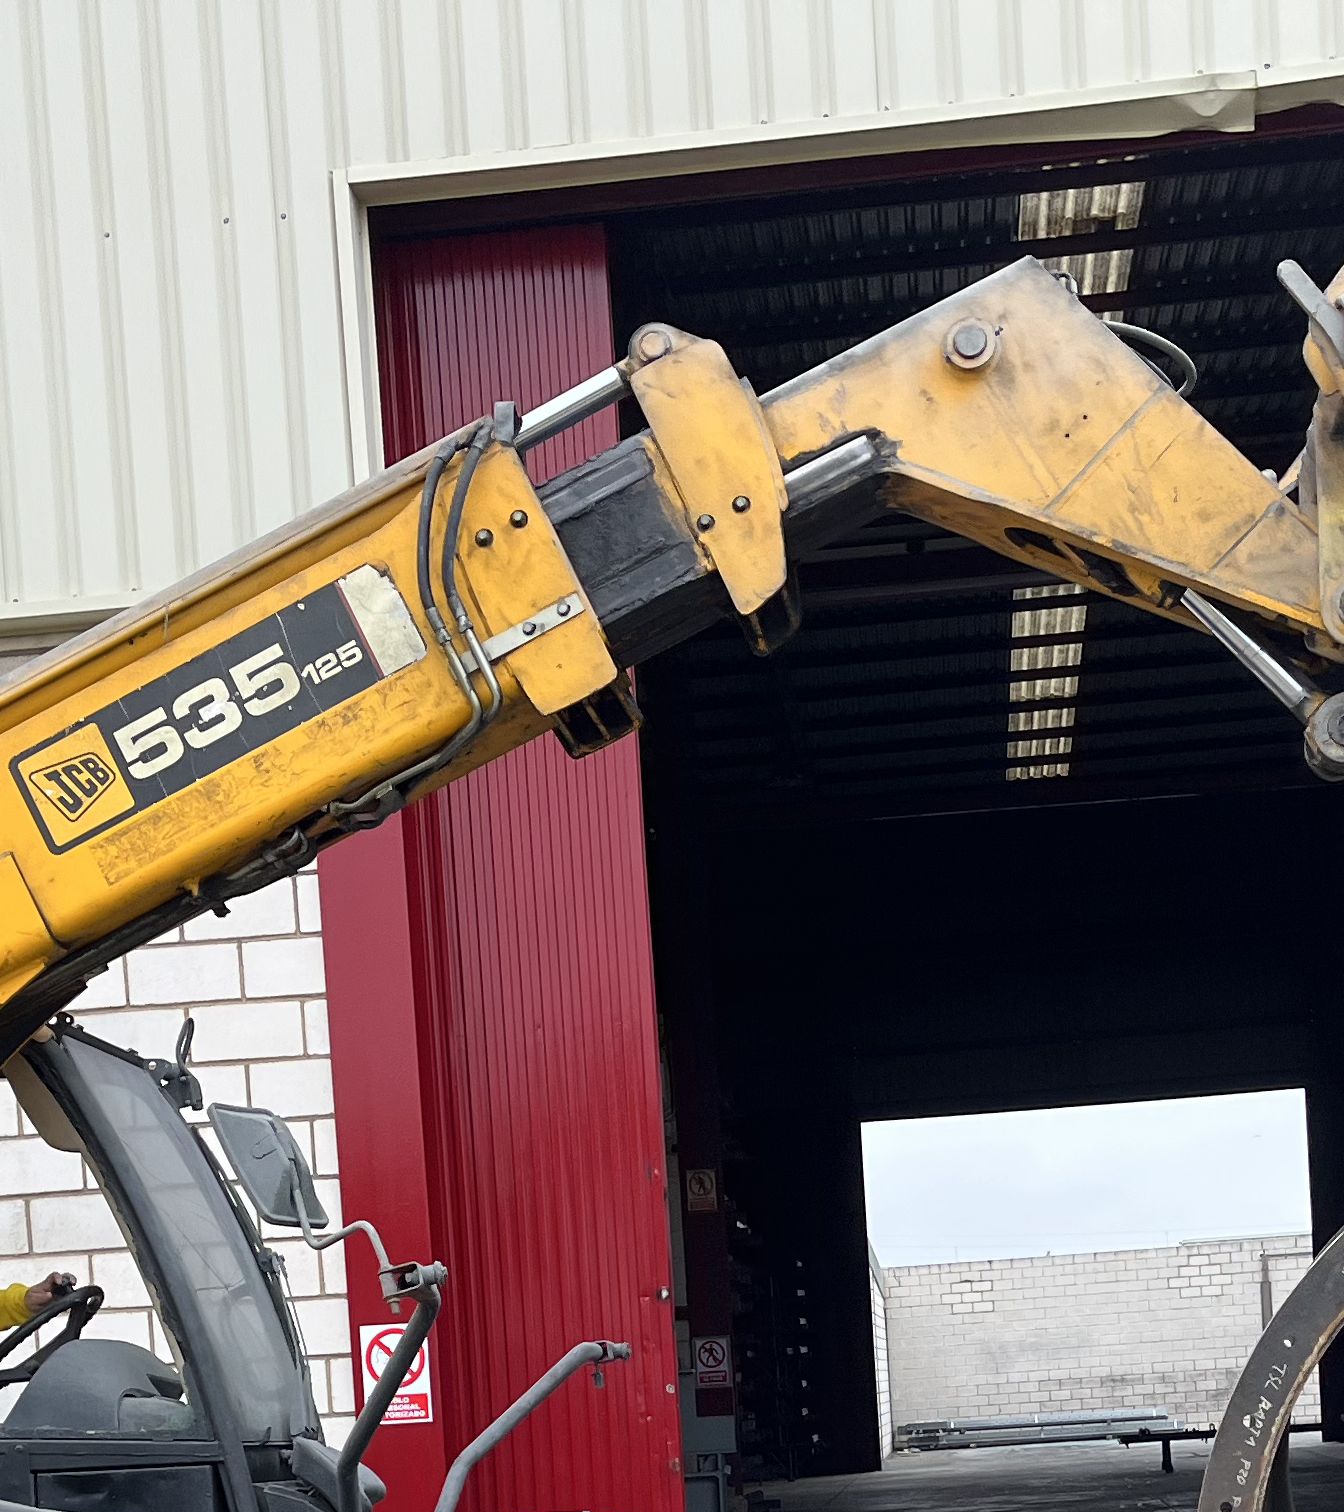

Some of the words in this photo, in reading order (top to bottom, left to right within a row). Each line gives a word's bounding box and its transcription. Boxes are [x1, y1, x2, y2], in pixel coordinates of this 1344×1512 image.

[113, 643, 301, 780] 535
[301, 640, 363, 685] 125
[43, 757, 110, 814] JCB
[384, 1410, 426, 1418] TORIZADO
